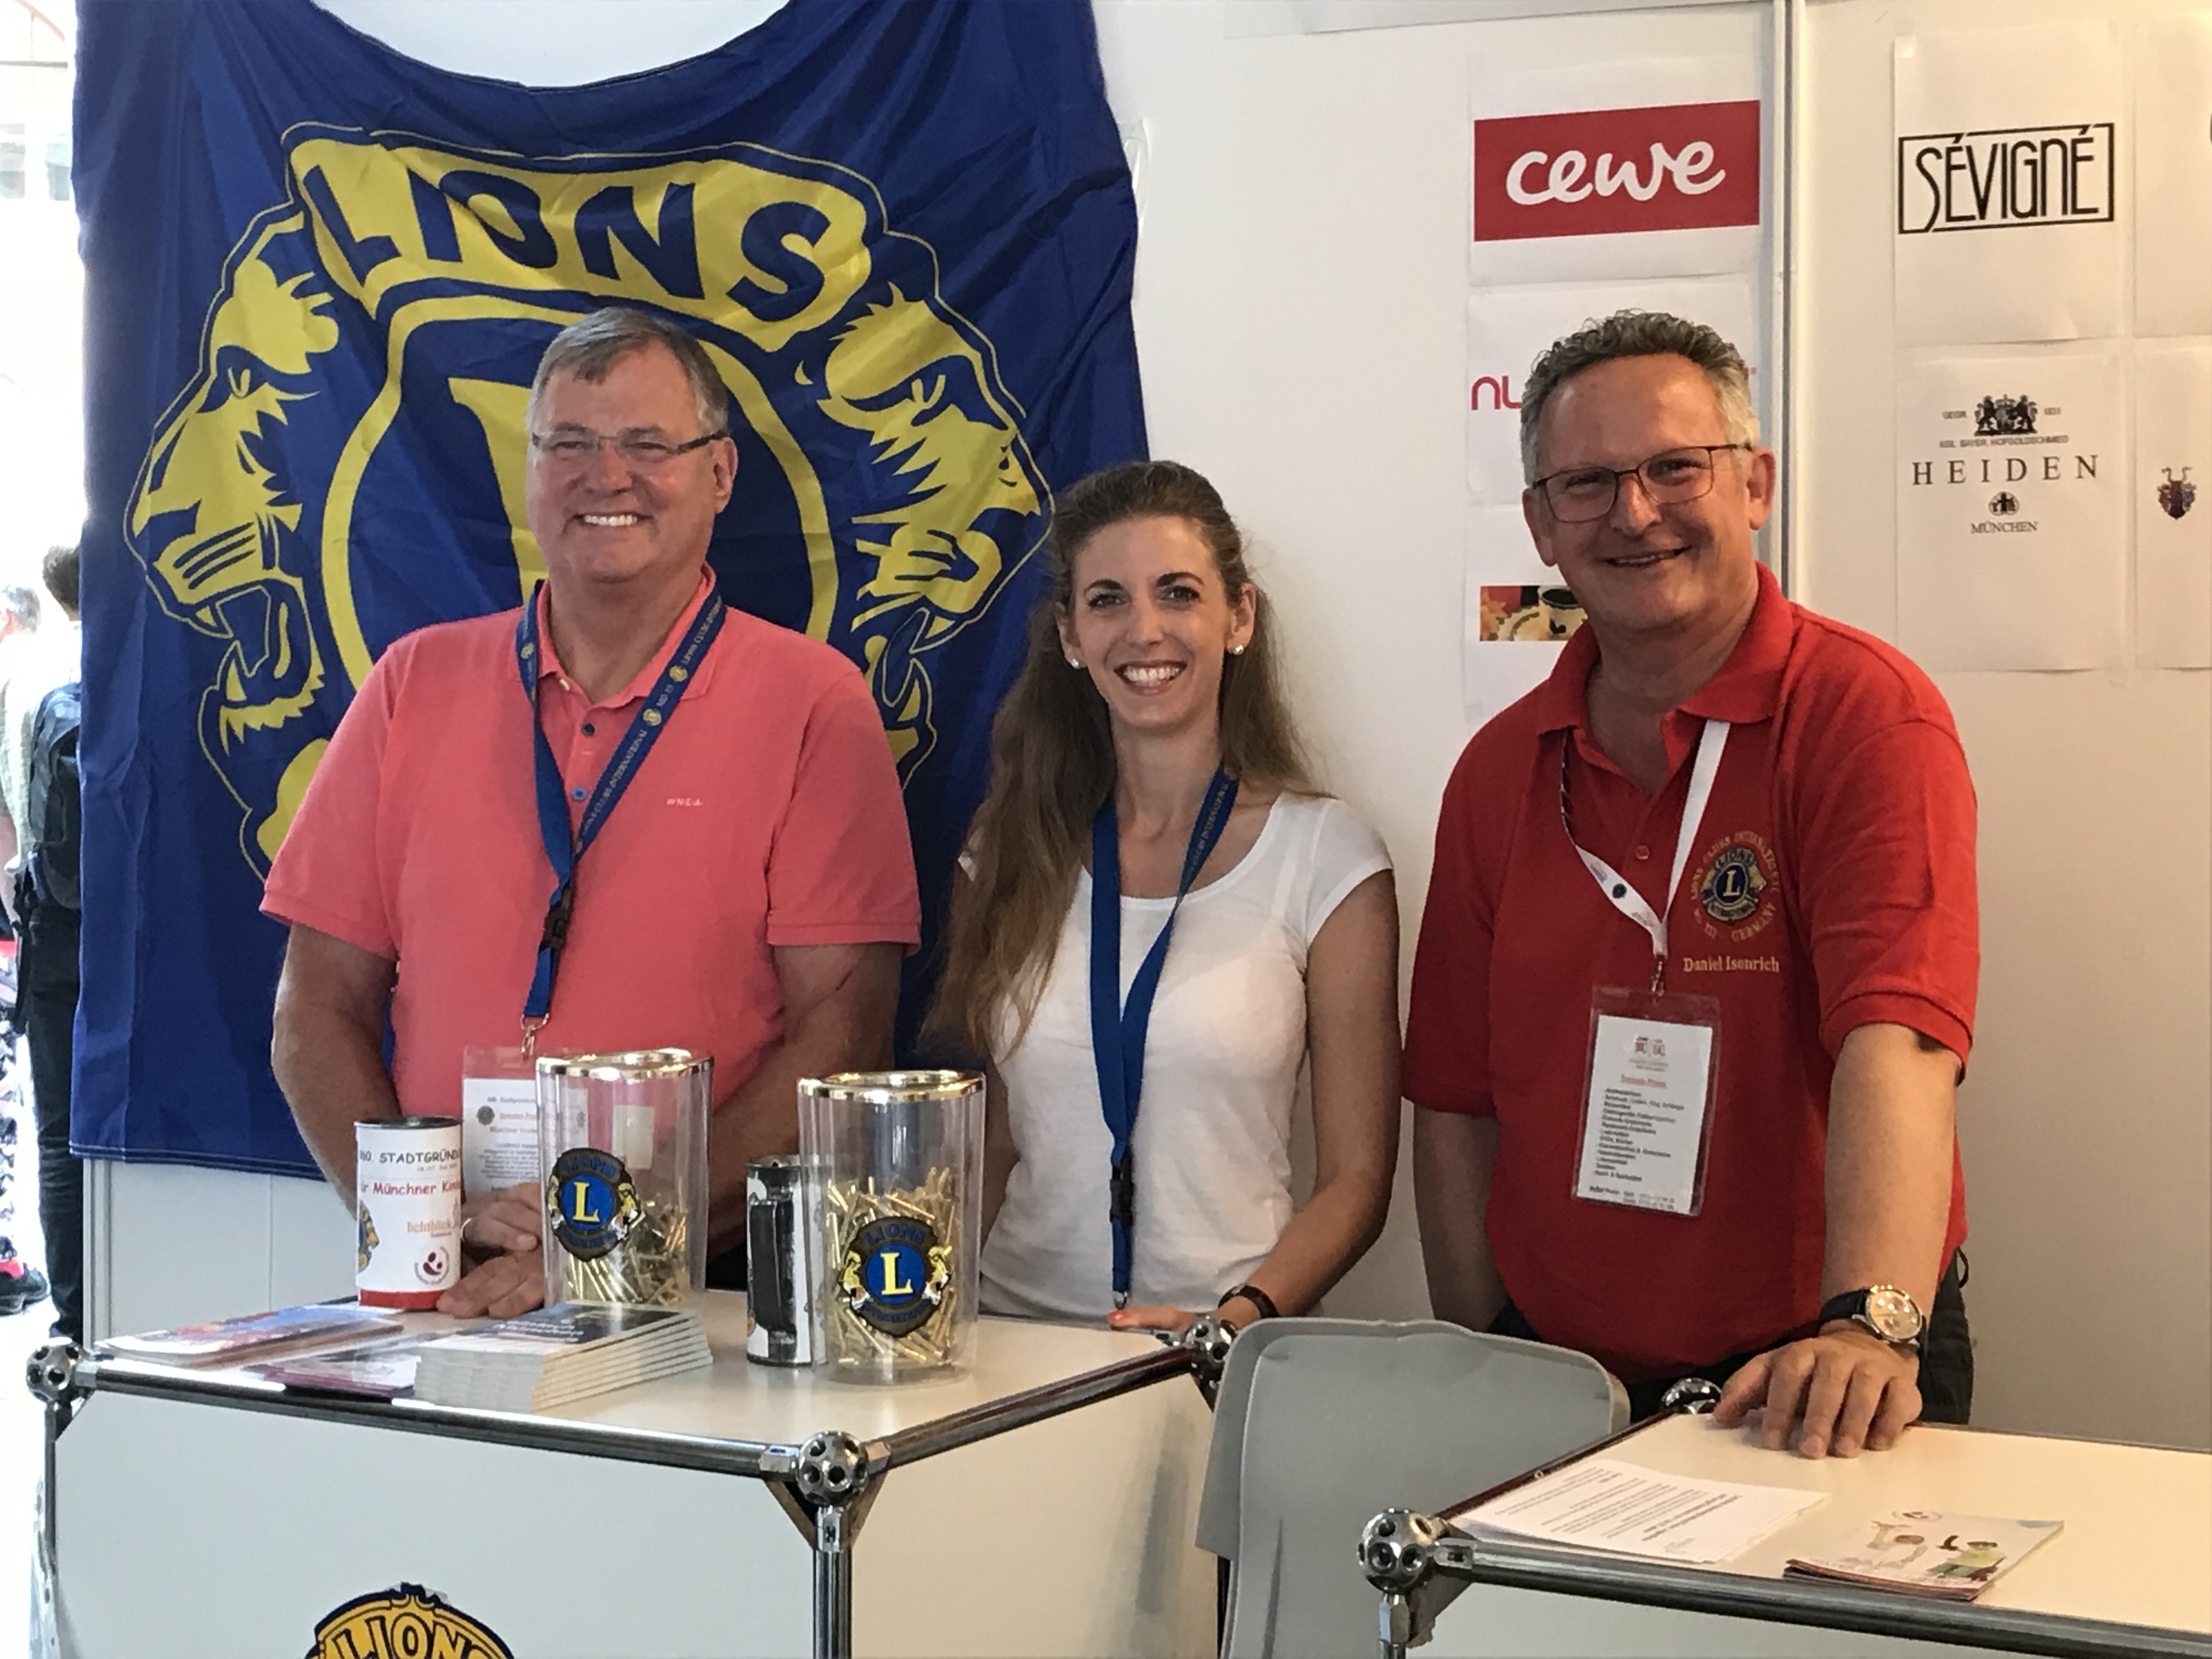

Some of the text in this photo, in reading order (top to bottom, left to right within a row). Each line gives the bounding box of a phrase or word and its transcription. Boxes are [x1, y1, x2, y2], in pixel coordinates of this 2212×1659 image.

[1506, 139, 1726, 206] cewe
[1915, 125, 2100, 233] SÉVIGNÉ
[302, 162, 838, 323] LIONS
[1912, 454, 2098, 485] HEIDEN
[1970, 521, 2038, 534] MÜNCHEN
[1723, 870, 1741, 896] L
[1683, 956, 1779, 972] Daniel Isenrich
[562, 1154, 615, 1177] LIONS
[373, 1181, 437, 1195] Münchner
[573, 1181, 600, 1223] L
[865, 1223, 924, 1244] LIONS
[880, 1252, 913, 1295] L
[331, 1611, 493, 1659] LION
